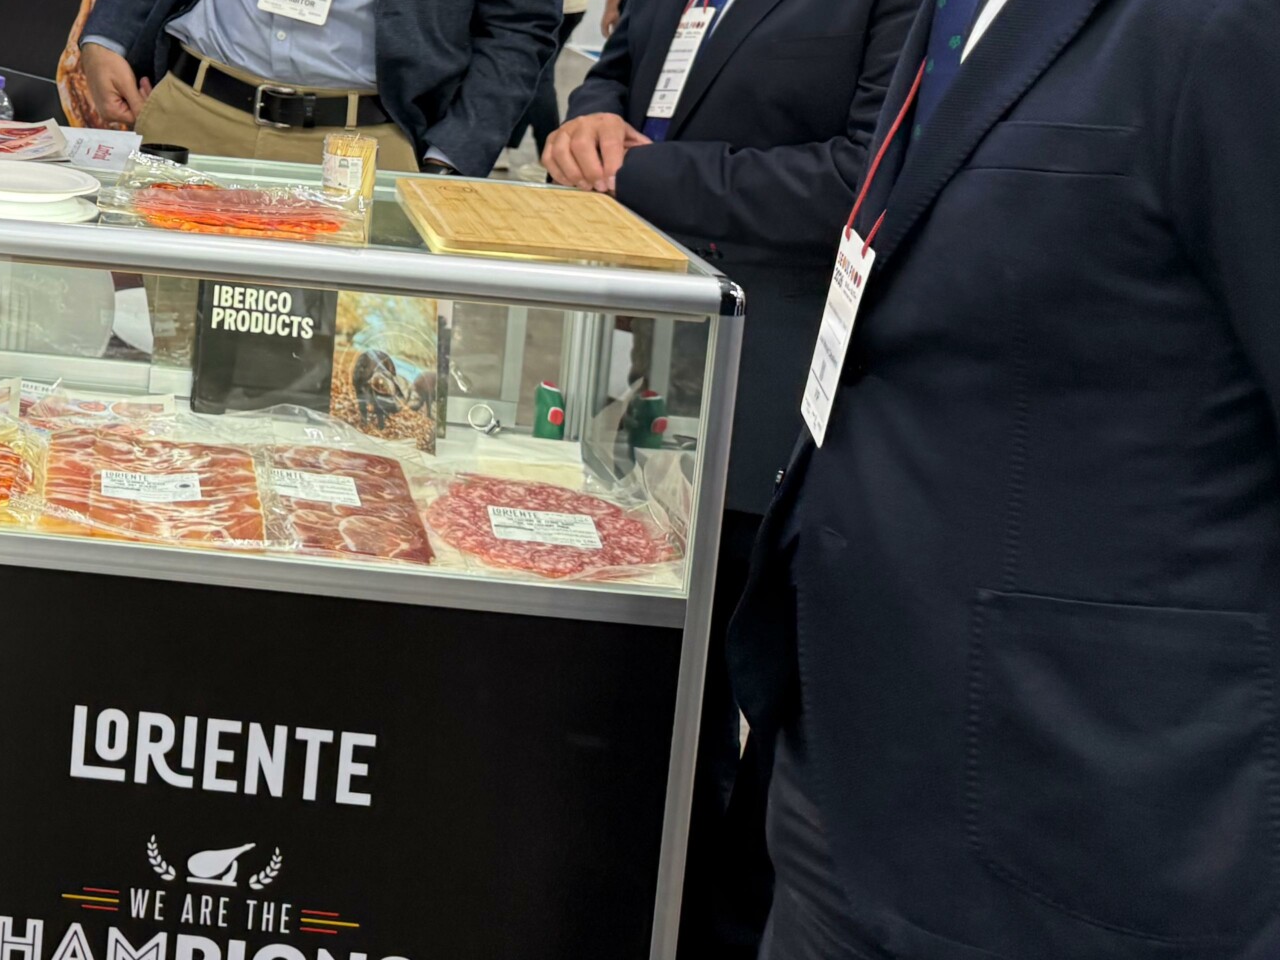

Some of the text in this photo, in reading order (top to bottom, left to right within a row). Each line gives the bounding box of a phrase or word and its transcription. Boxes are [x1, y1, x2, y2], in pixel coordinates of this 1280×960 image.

[213, 284, 292, 314] IBERICO
[211, 307, 314, 340] PRODUCTS
[69, 704, 377, 807] LORIENTE
[130, 887, 292, 934] WE ARE THE
